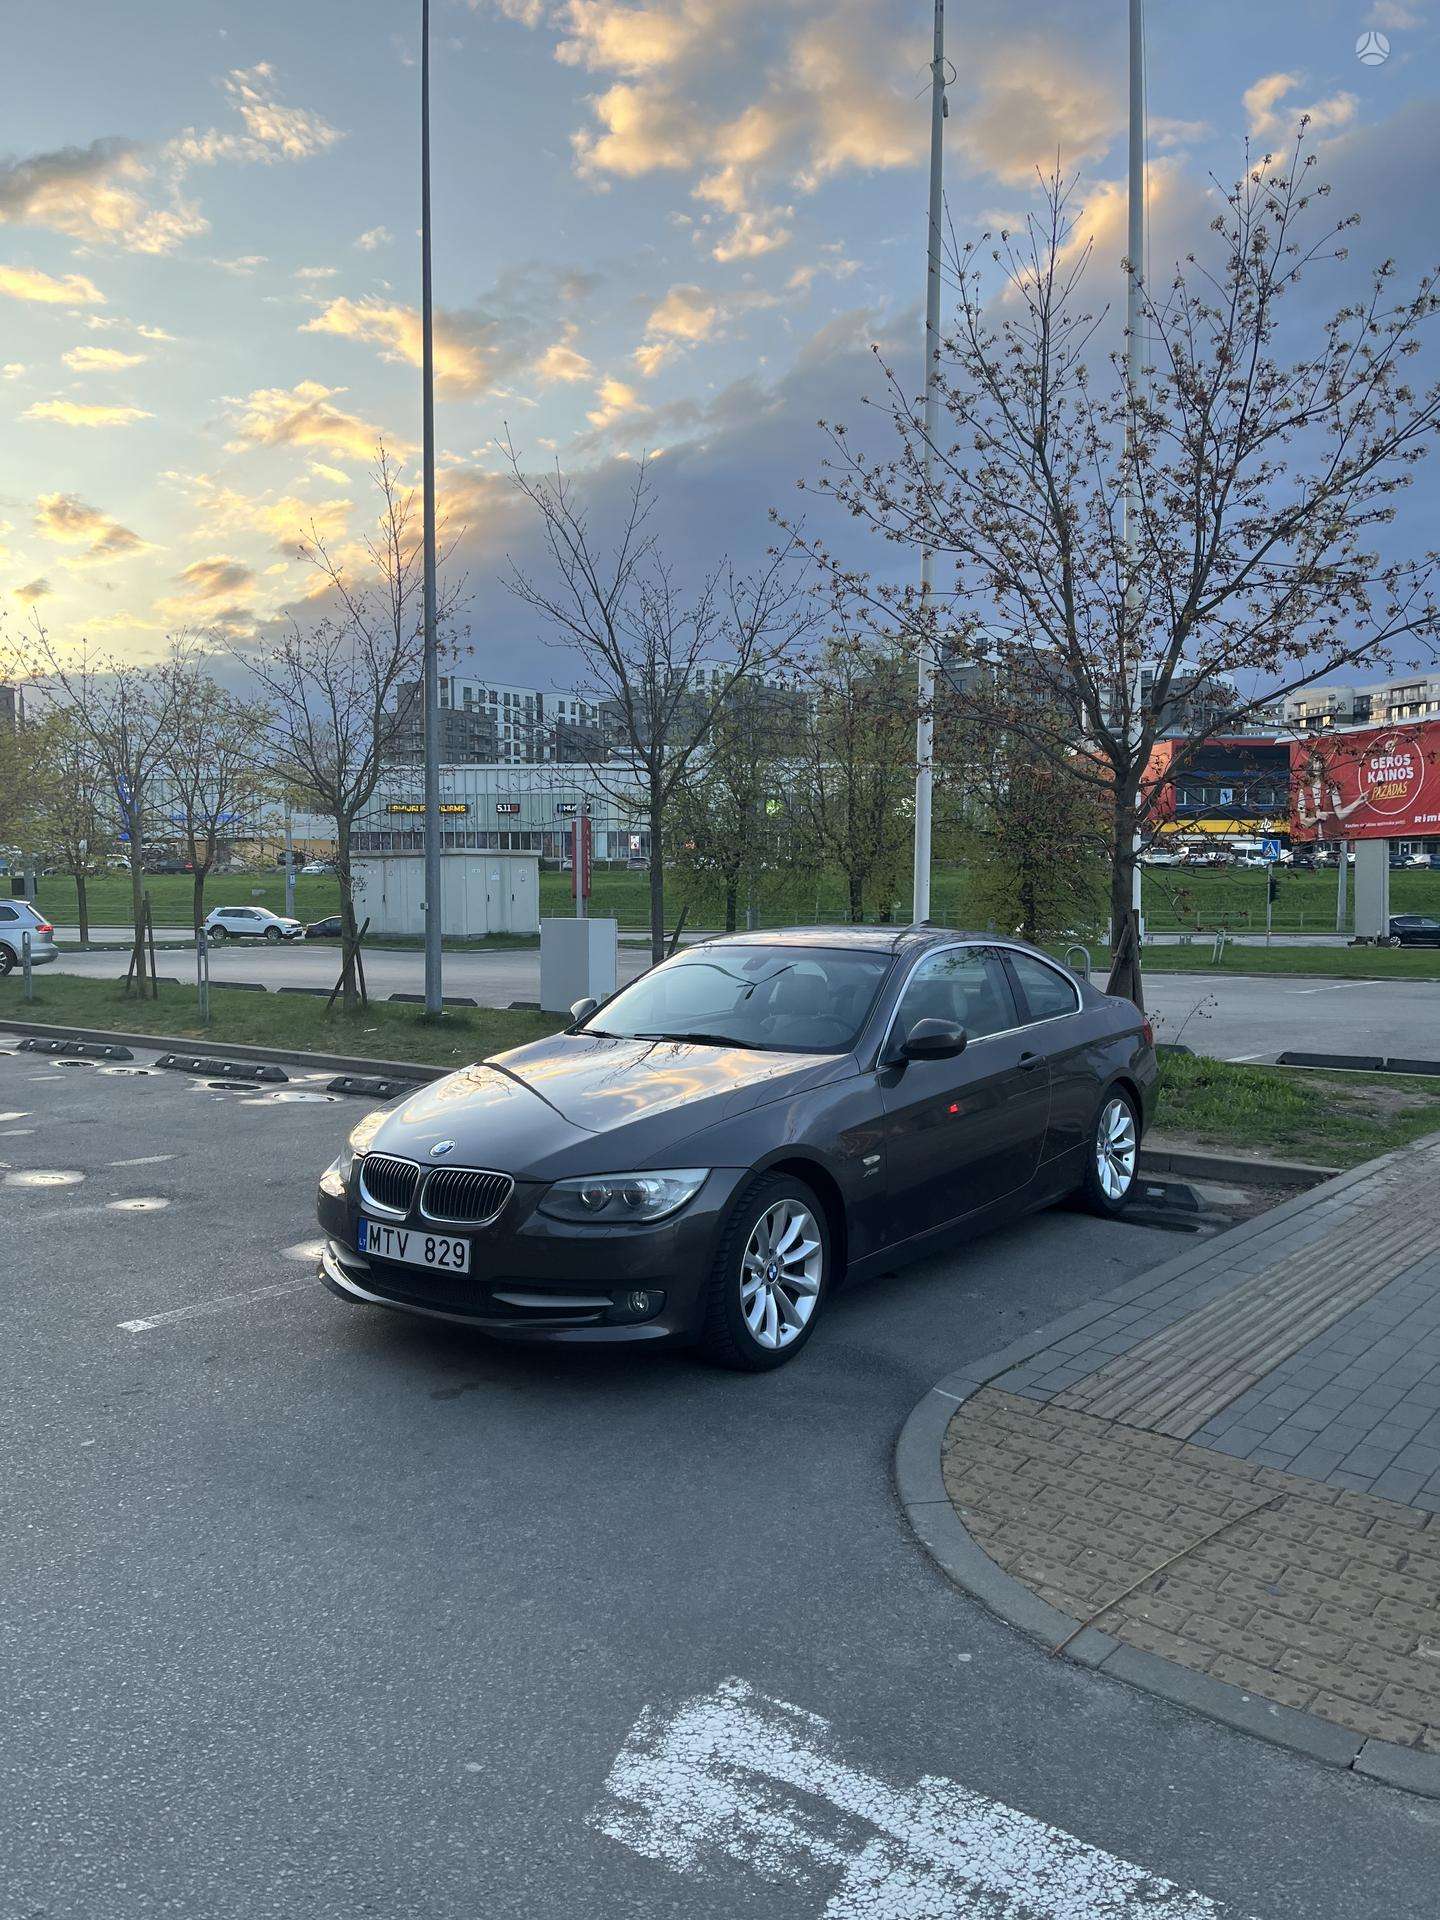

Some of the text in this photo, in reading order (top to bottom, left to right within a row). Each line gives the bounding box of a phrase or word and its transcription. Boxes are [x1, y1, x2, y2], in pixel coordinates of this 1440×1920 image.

[1371, 754, 1411, 769] GEROS
[1367, 767, 1414, 783] KAINOS
[370, 1224, 465, 1268] MTV 829
